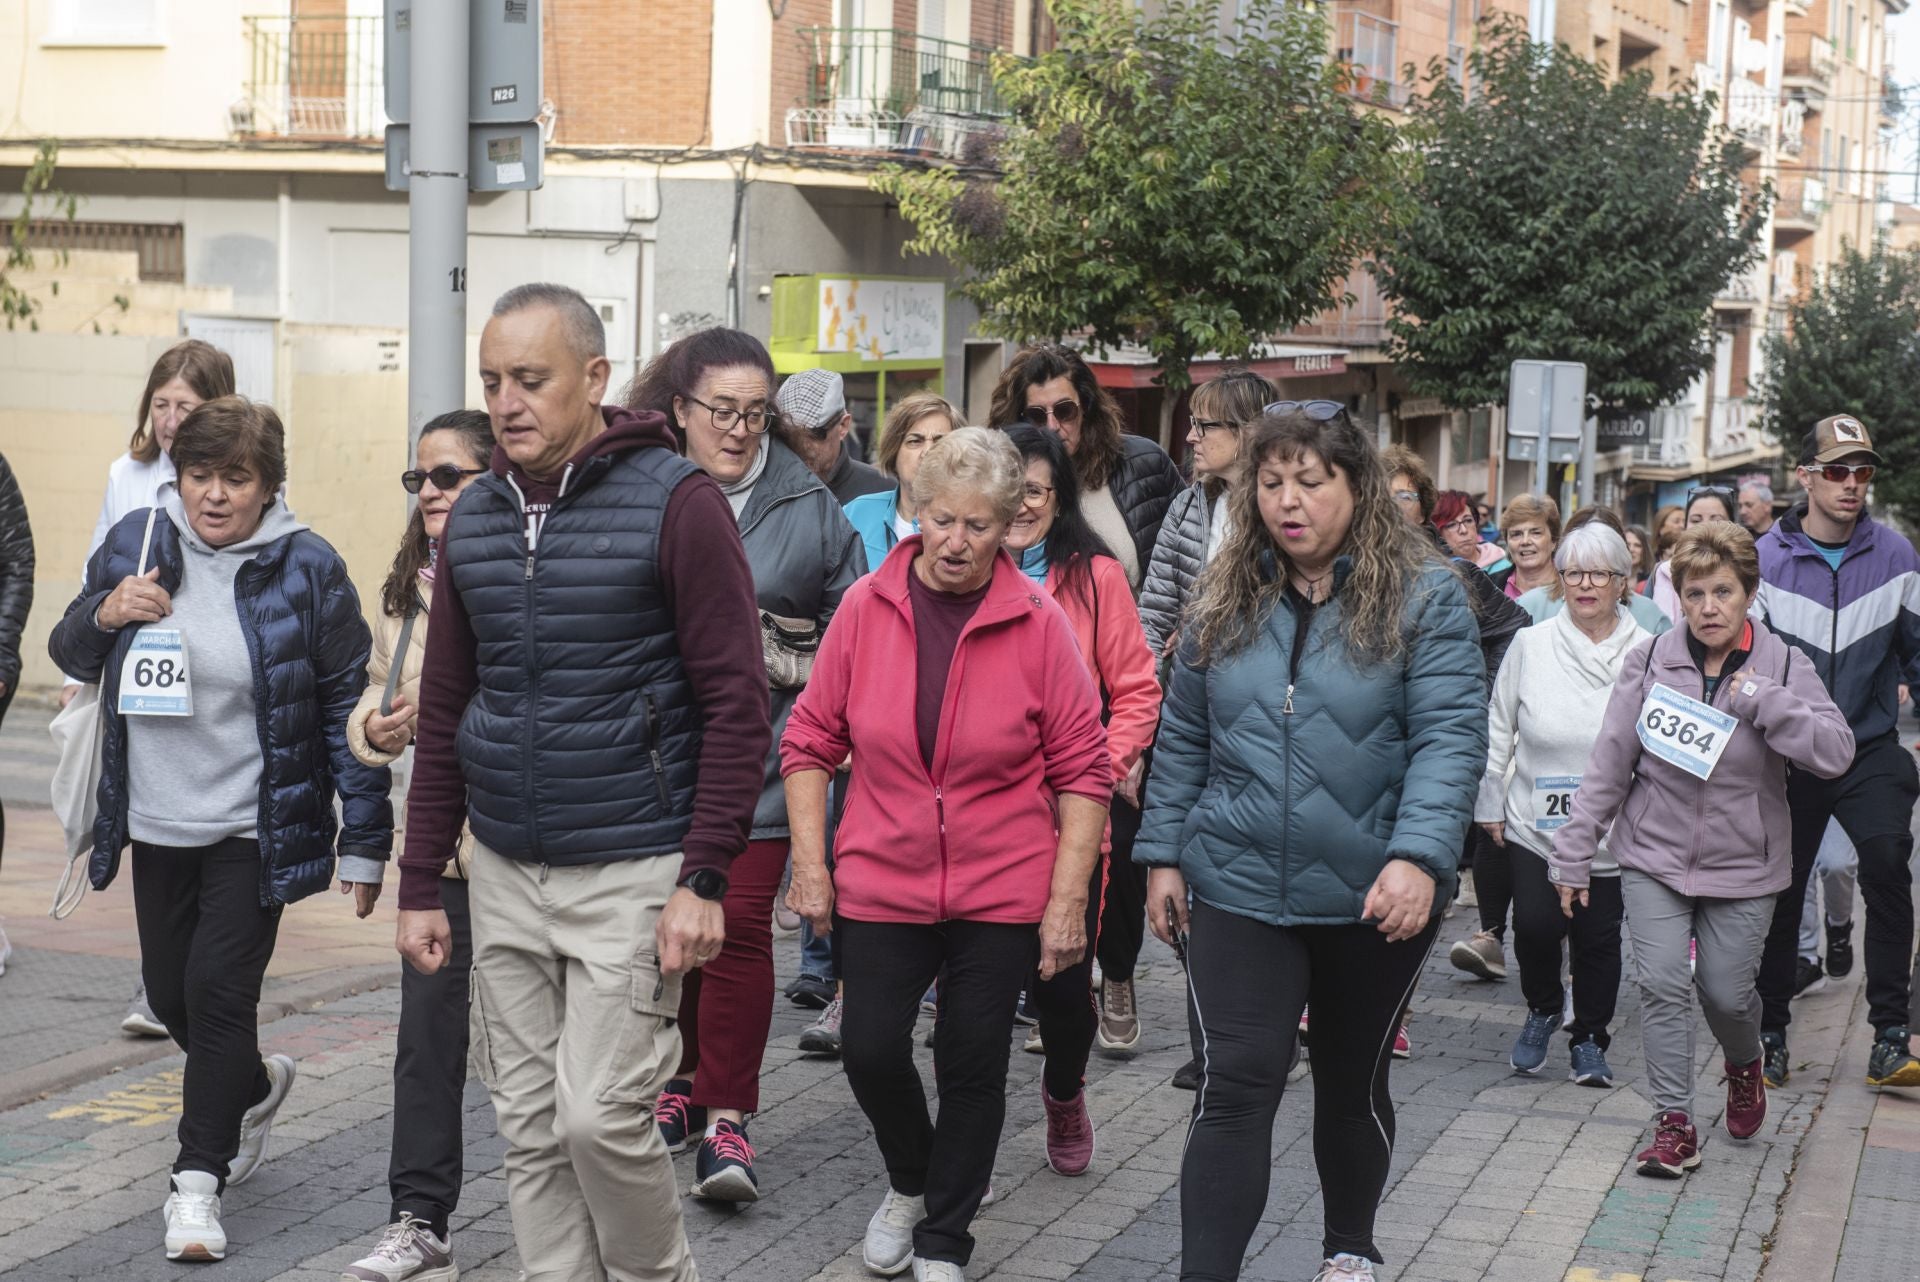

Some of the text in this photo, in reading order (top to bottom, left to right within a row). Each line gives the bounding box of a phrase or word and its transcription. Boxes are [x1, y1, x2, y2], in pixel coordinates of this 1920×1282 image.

[494, 88, 515, 101] N26
[1294, 354, 1332, 372] REGALOS
[1647, 707, 1715, 754] 6364
[1546, 793, 1571, 816] 26
